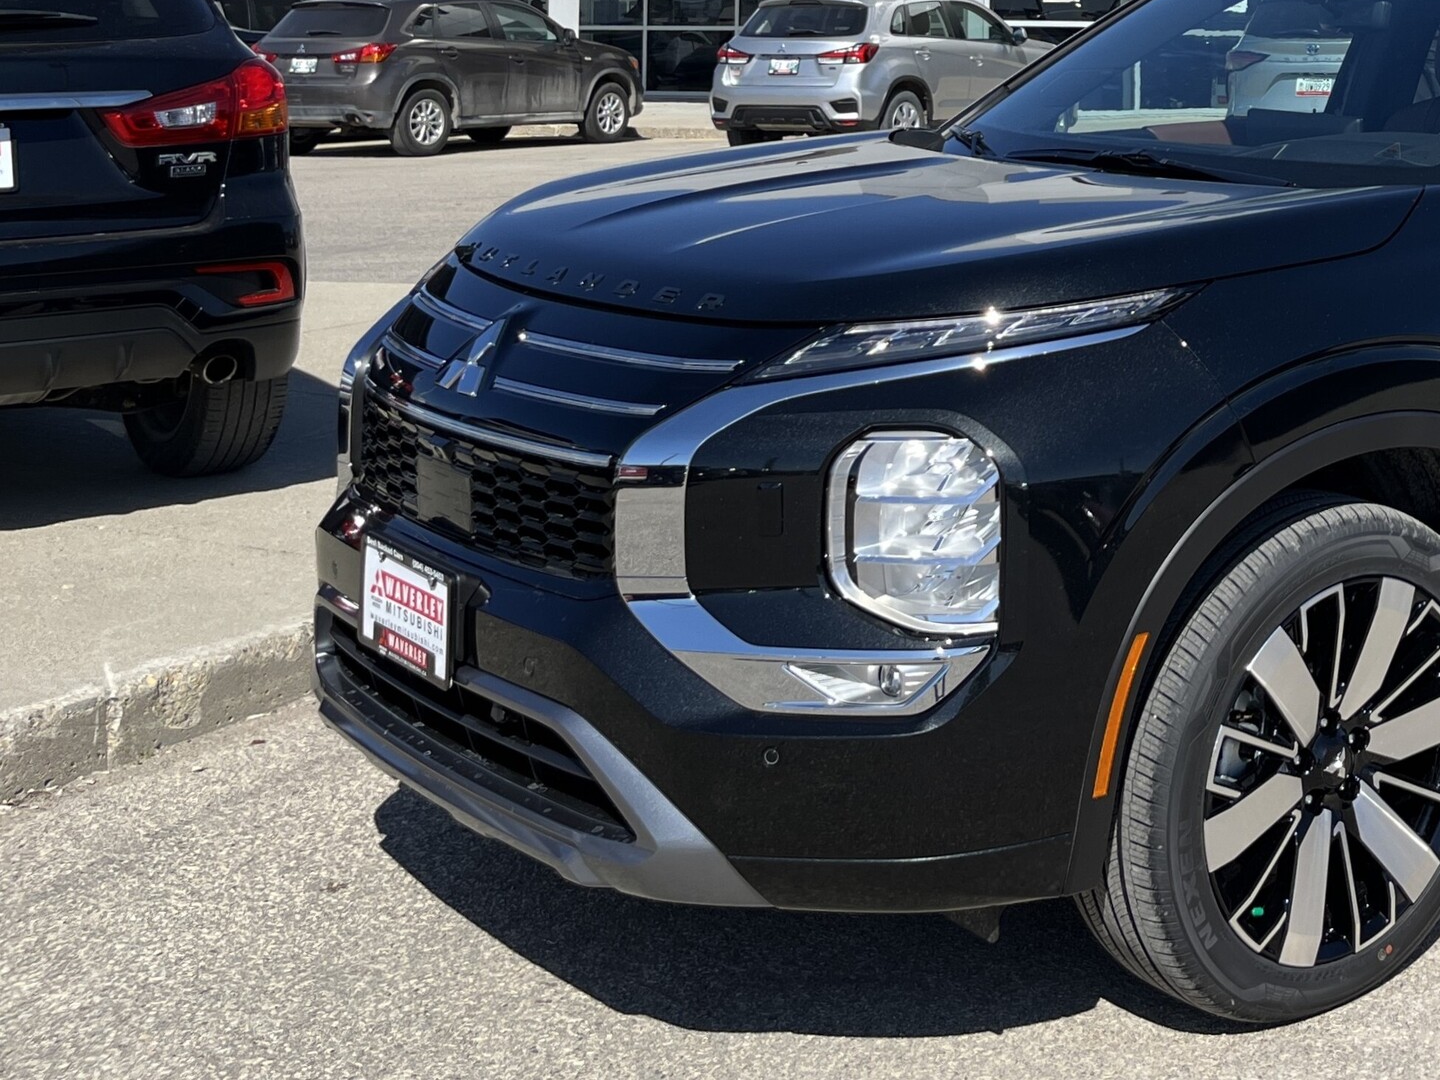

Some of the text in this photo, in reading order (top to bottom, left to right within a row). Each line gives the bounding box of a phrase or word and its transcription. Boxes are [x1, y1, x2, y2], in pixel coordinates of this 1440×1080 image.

[159, 151, 217, 165] RVR
[385, 575, 444, 621] WAVERLEY
[385, 600, 443, 641] MITSUBISHI
[388, 632, 427, 667] WAVERLEY
[1178, 822, 1218, 951] NEXEN
